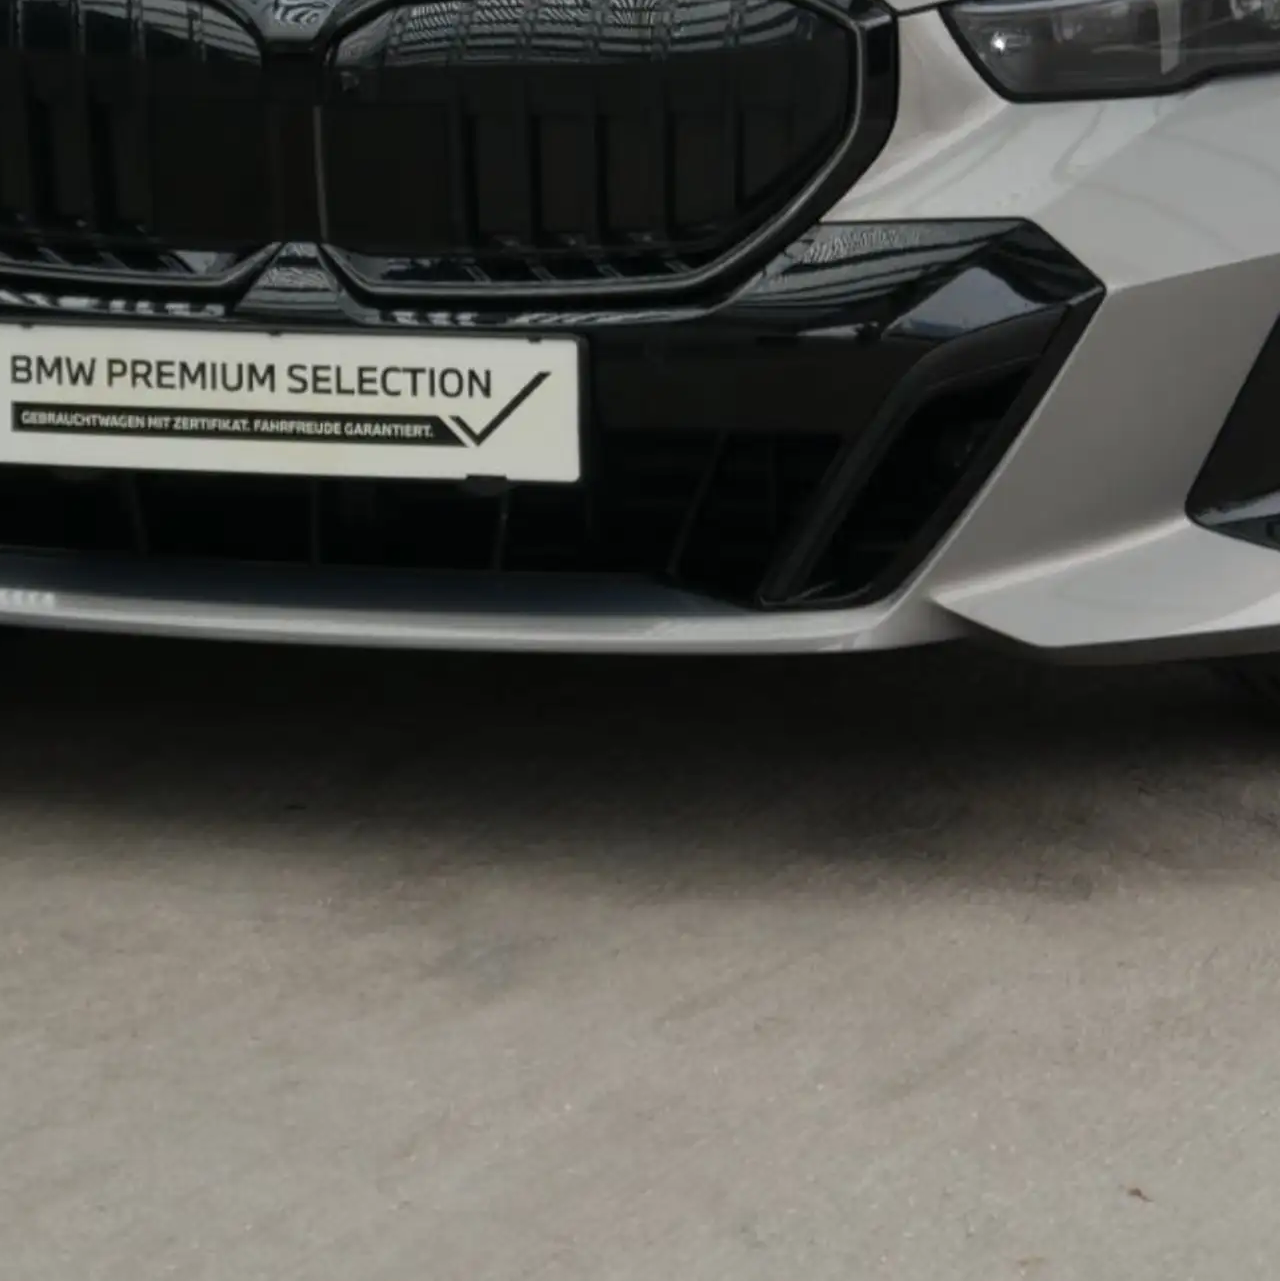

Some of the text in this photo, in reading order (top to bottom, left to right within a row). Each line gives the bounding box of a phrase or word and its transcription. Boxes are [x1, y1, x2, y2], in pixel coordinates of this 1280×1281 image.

[11, 355, 492, 399] BMW PREMIUM SELECTION
[21, 410, 434, 438] GEBRAUCHTWAGEN MIT ZERTIFIKAT. FAHRFREUDE GARANTIERT.
